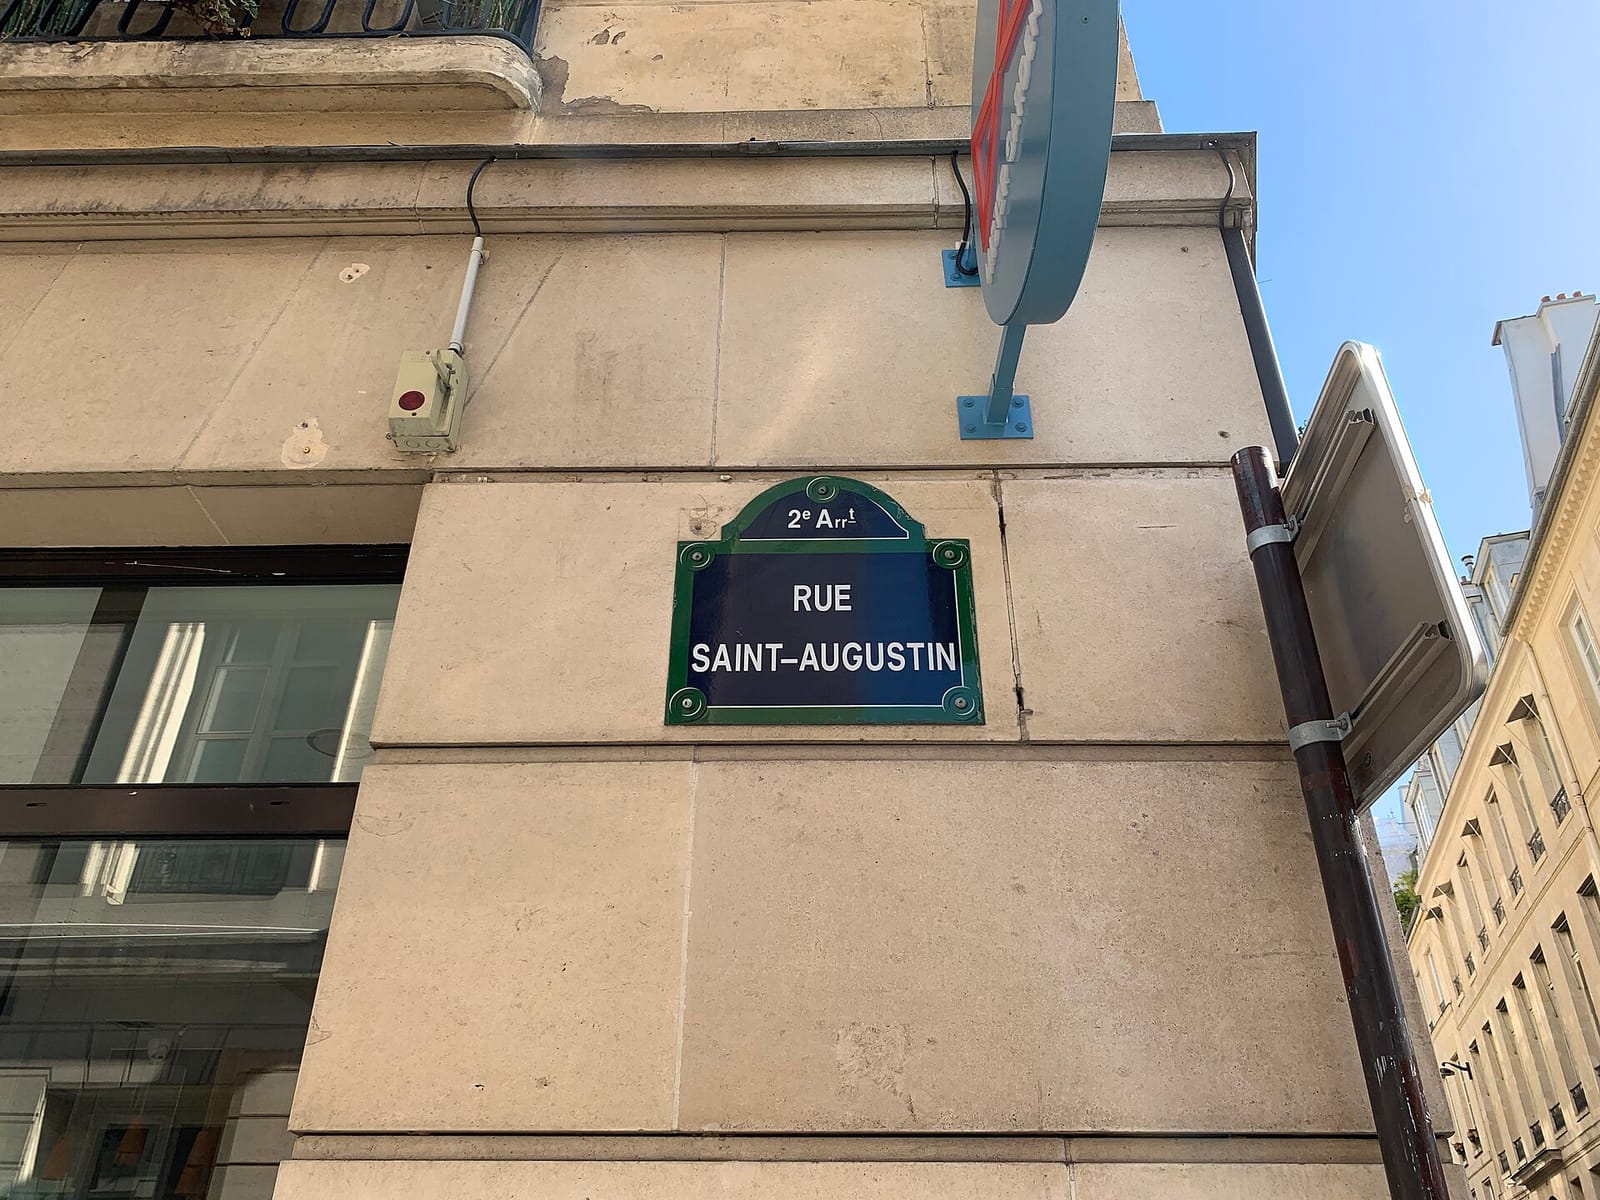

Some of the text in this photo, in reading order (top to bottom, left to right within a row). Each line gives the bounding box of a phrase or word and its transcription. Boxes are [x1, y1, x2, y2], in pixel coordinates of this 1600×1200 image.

[787, 508, 811, 529] 2e
[793, 584, 852, 612] RUE
[691, 642, 956, 673] SAINT-AUGUSTIN
